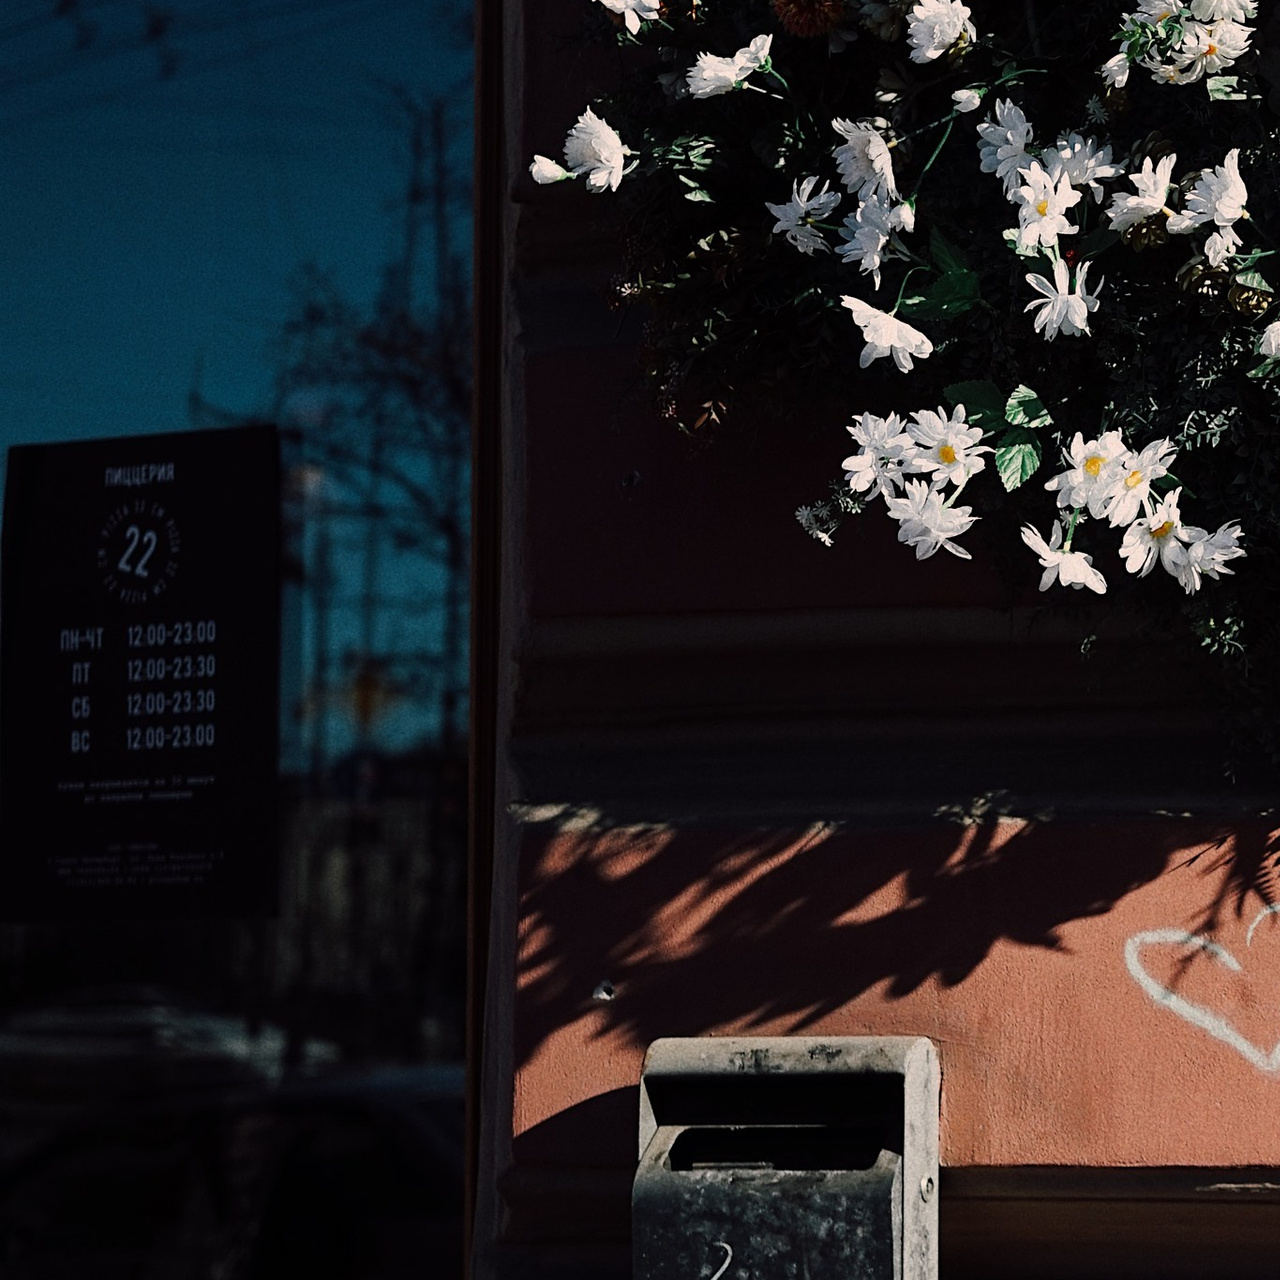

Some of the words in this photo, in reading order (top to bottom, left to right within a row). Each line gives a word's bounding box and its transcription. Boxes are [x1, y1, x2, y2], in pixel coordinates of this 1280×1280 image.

[105, 462, 174, 487] ПИЦЦЕРИЯ
[118, 524, 157, 578] 22
[60, 627, 104, 651] ПН-ЧТ
[72, 661, 91, 686] ПТ
[72, 696, 90, 719] СБ
[71, 730, 90, 753] ВС
